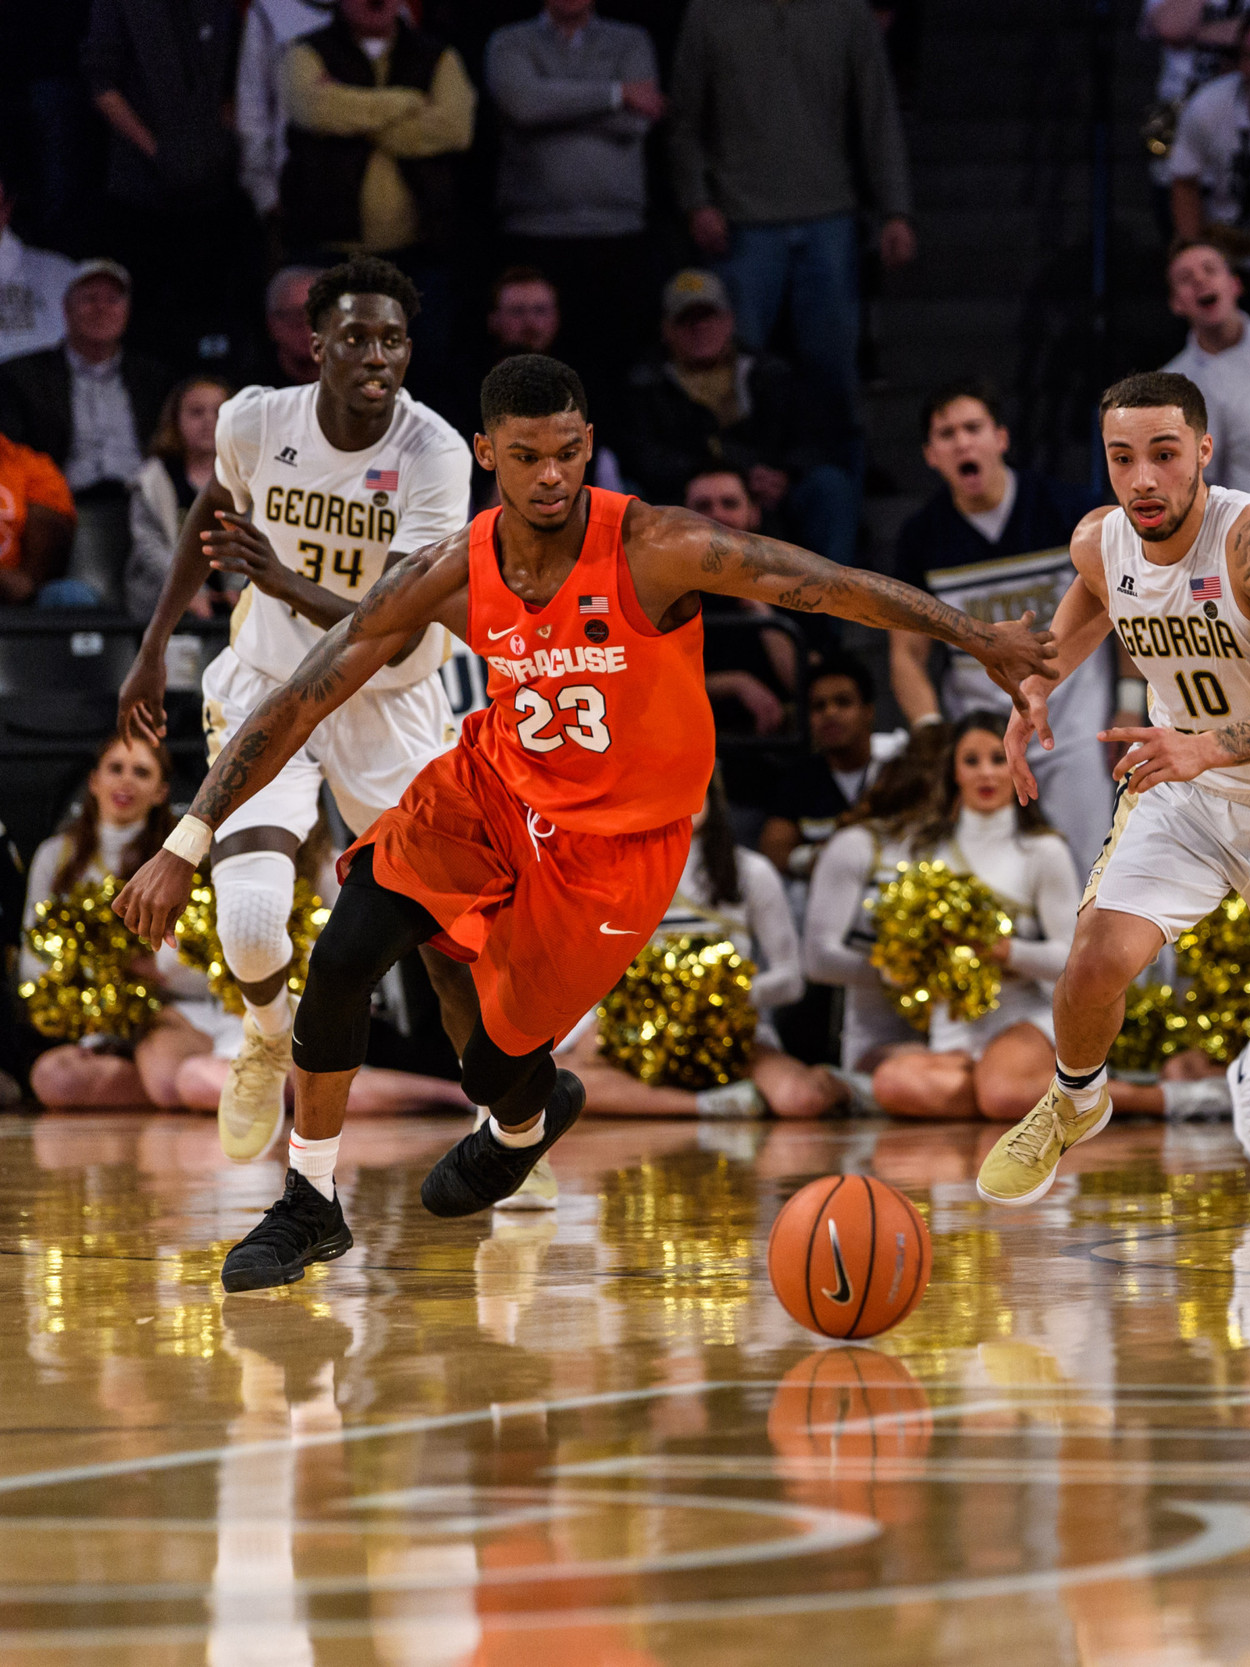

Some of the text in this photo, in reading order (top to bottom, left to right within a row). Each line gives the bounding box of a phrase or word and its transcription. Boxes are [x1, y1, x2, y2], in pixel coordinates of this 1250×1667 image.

[265, 484, 397, 545] GEORGIA
[296, 538, 365, 589] 34
[1117, 615, 1247, 660] GEORGIA
[487, 645, 628, 685] SYRACUSE
[514, 684, 612, 754] 23
[1174, 669, 1232, 719] 10
